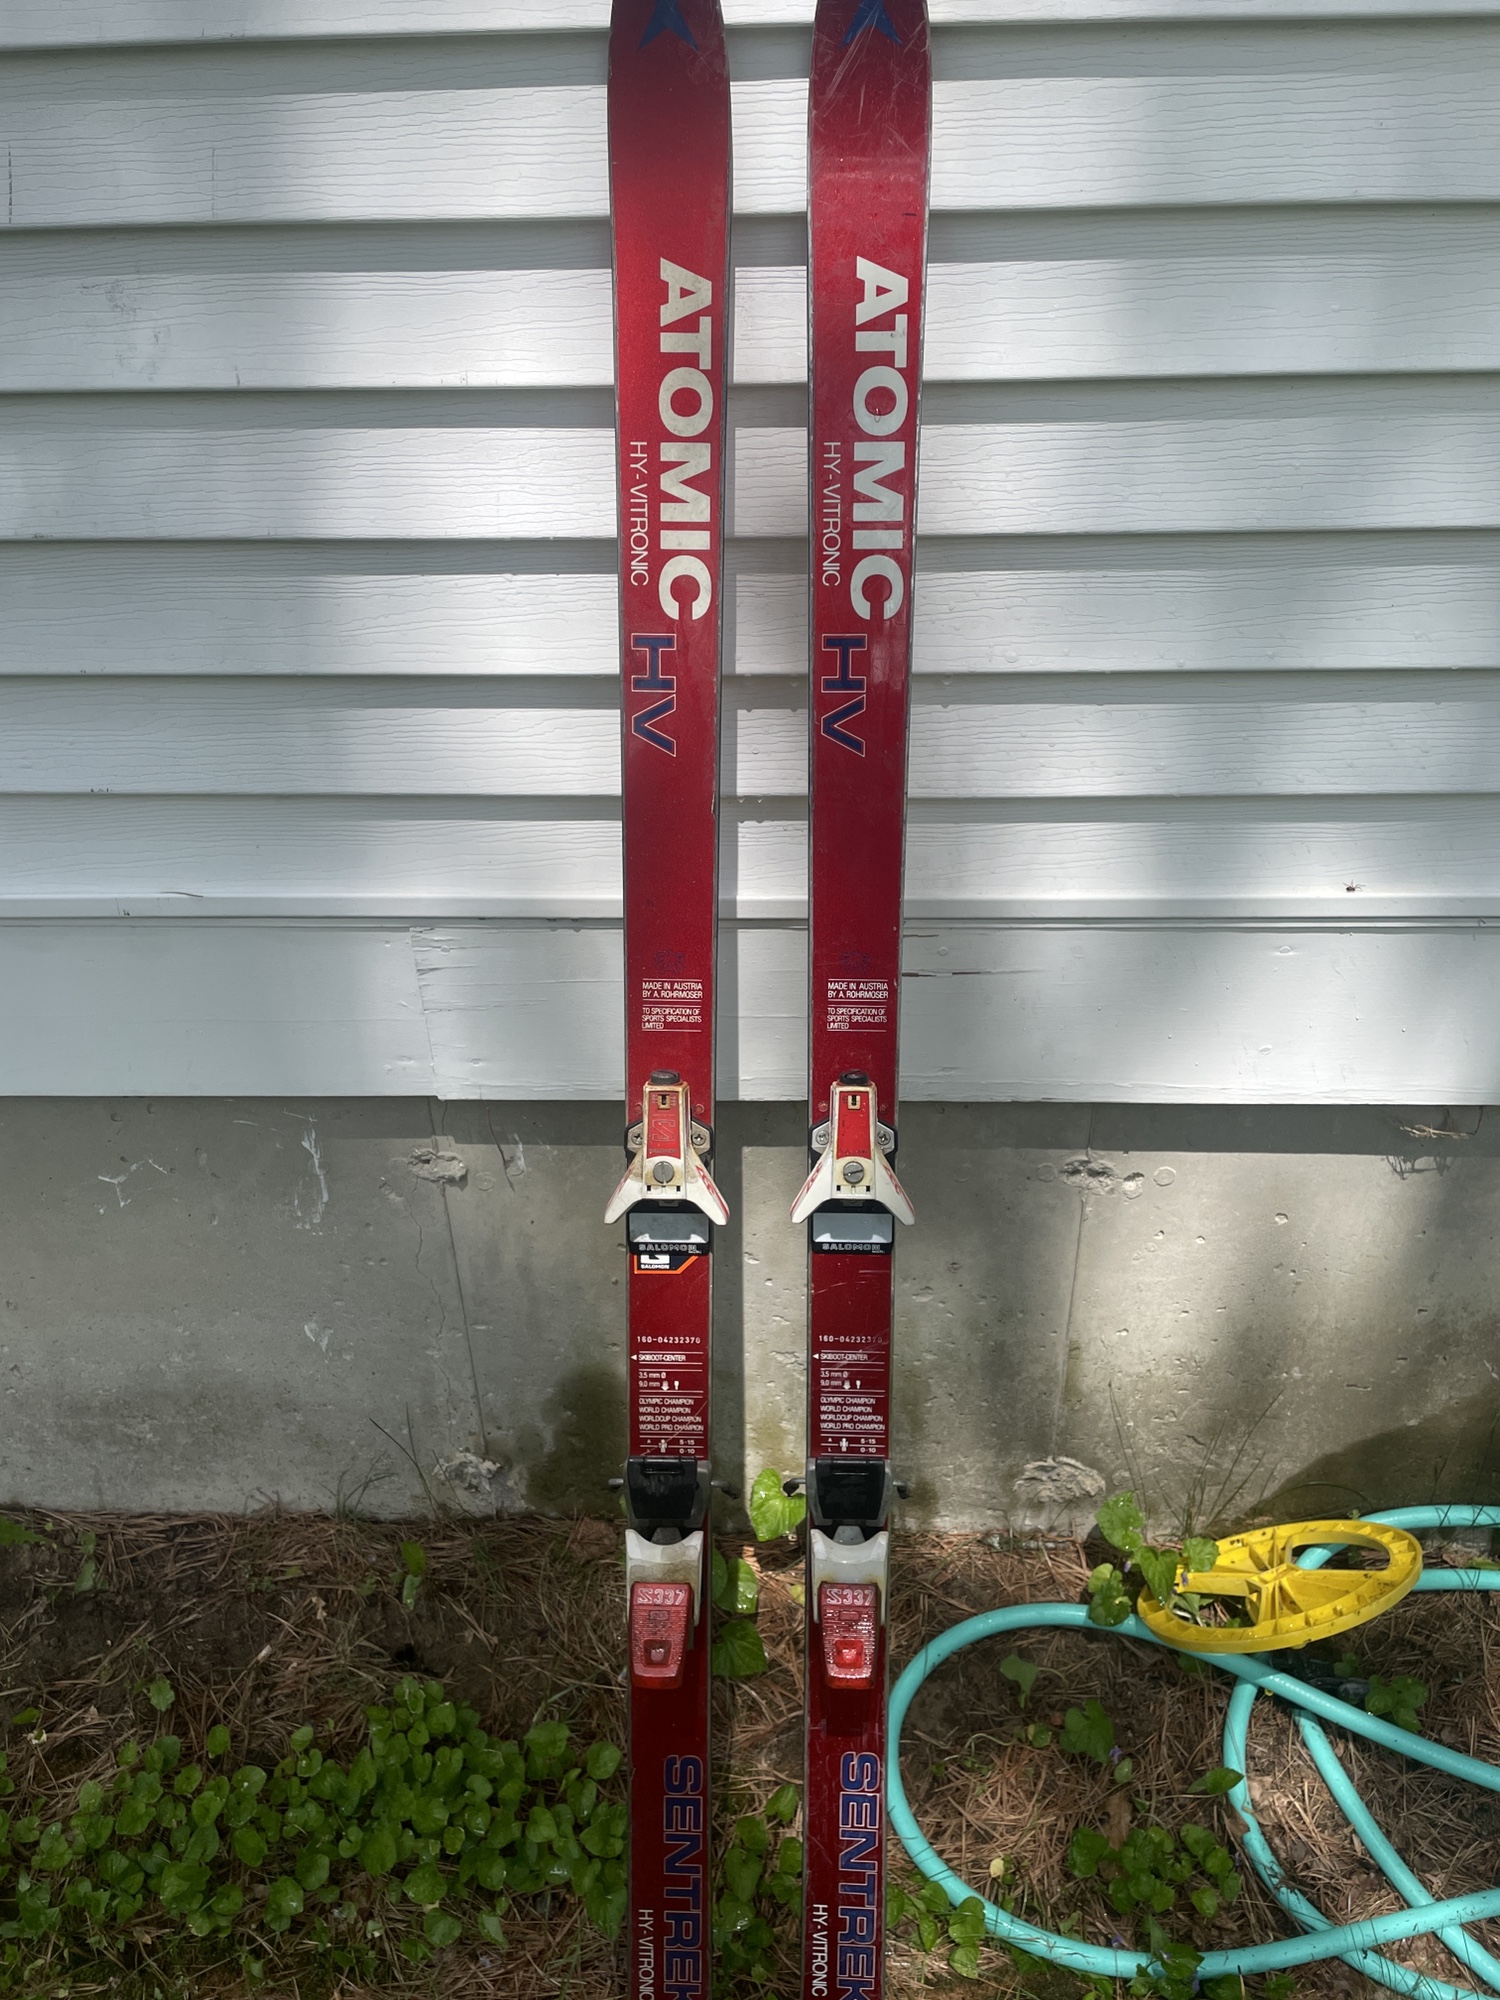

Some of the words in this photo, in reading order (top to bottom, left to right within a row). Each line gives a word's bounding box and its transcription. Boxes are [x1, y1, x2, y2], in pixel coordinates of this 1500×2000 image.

[659, 257, 713, 620] ATOMIC
[849, 256, 909, 620] ATOMIC
[631, 632, 677, 757] HV
[821, 632, 868, 757] HV
[642, 982, 662, 990] MADE
[663, 982, 671, 990] IN
[673, 982, 703, 991] AUSTRIA
[828, 982, 848, 990] MADE
[849, 982, 857, 990] IN
[859, 982, 889, 991] AUSTRIA
[642, 990, 652, 998] BY
[660, 991, 703, 999] ROHRMOSER
[828, 990, 837, 998] BY
[846, 991, 889, 999] ROHRMOSER
[651, 1007, 692, 1015] SPECIFICATION
[836, 1007, 877, 1015] SPECIFICATION
[666, 1015, 702, 1023] SPECIALISTS
[851, 1015, 888, 1023] SPECIALISTS
[641, 1022, 665, 1030] LIMITED
[826, 1022, 850, 1030] LIMITED
[663, 1398, 695, 1406] CHAMPION
[845, 1397, 876, 1405] CHAMPION
[673, 1424, 704, 1432] CHAMPION
[855, 1423, 886, 1431] CHAMPION
